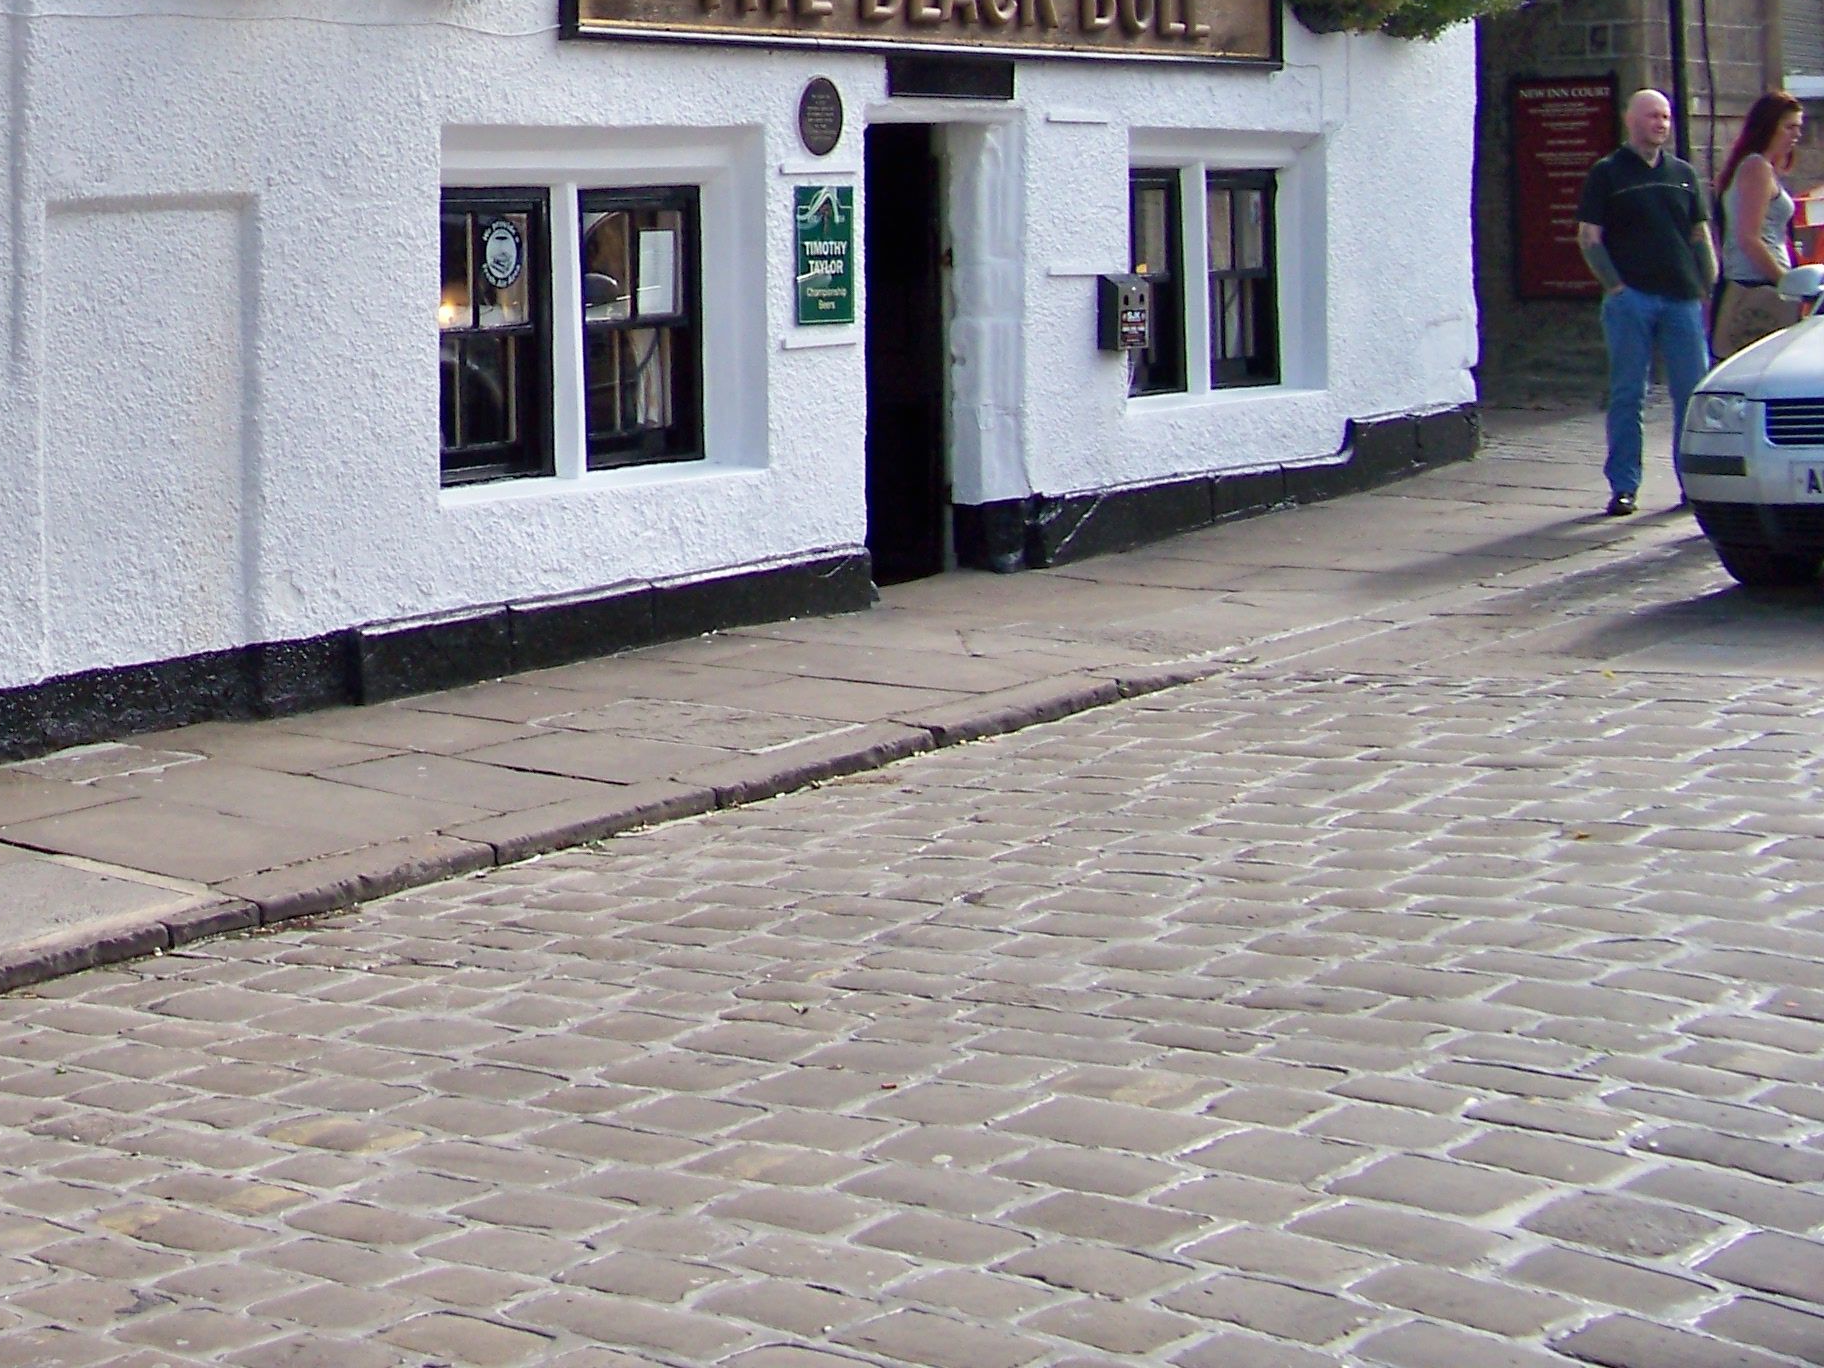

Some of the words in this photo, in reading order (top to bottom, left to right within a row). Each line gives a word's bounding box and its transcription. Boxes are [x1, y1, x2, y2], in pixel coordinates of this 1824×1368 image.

[1519, 88, 1545, 98] NEW
[1546, 87, 1569, 97] INN
[1570, 86, 1611, 97] COURT
[804, 240, 848, 256] TIMOTHY
[808, 259, 845, 276] TAYLOR
[1806, 467, 1824, 494] A
